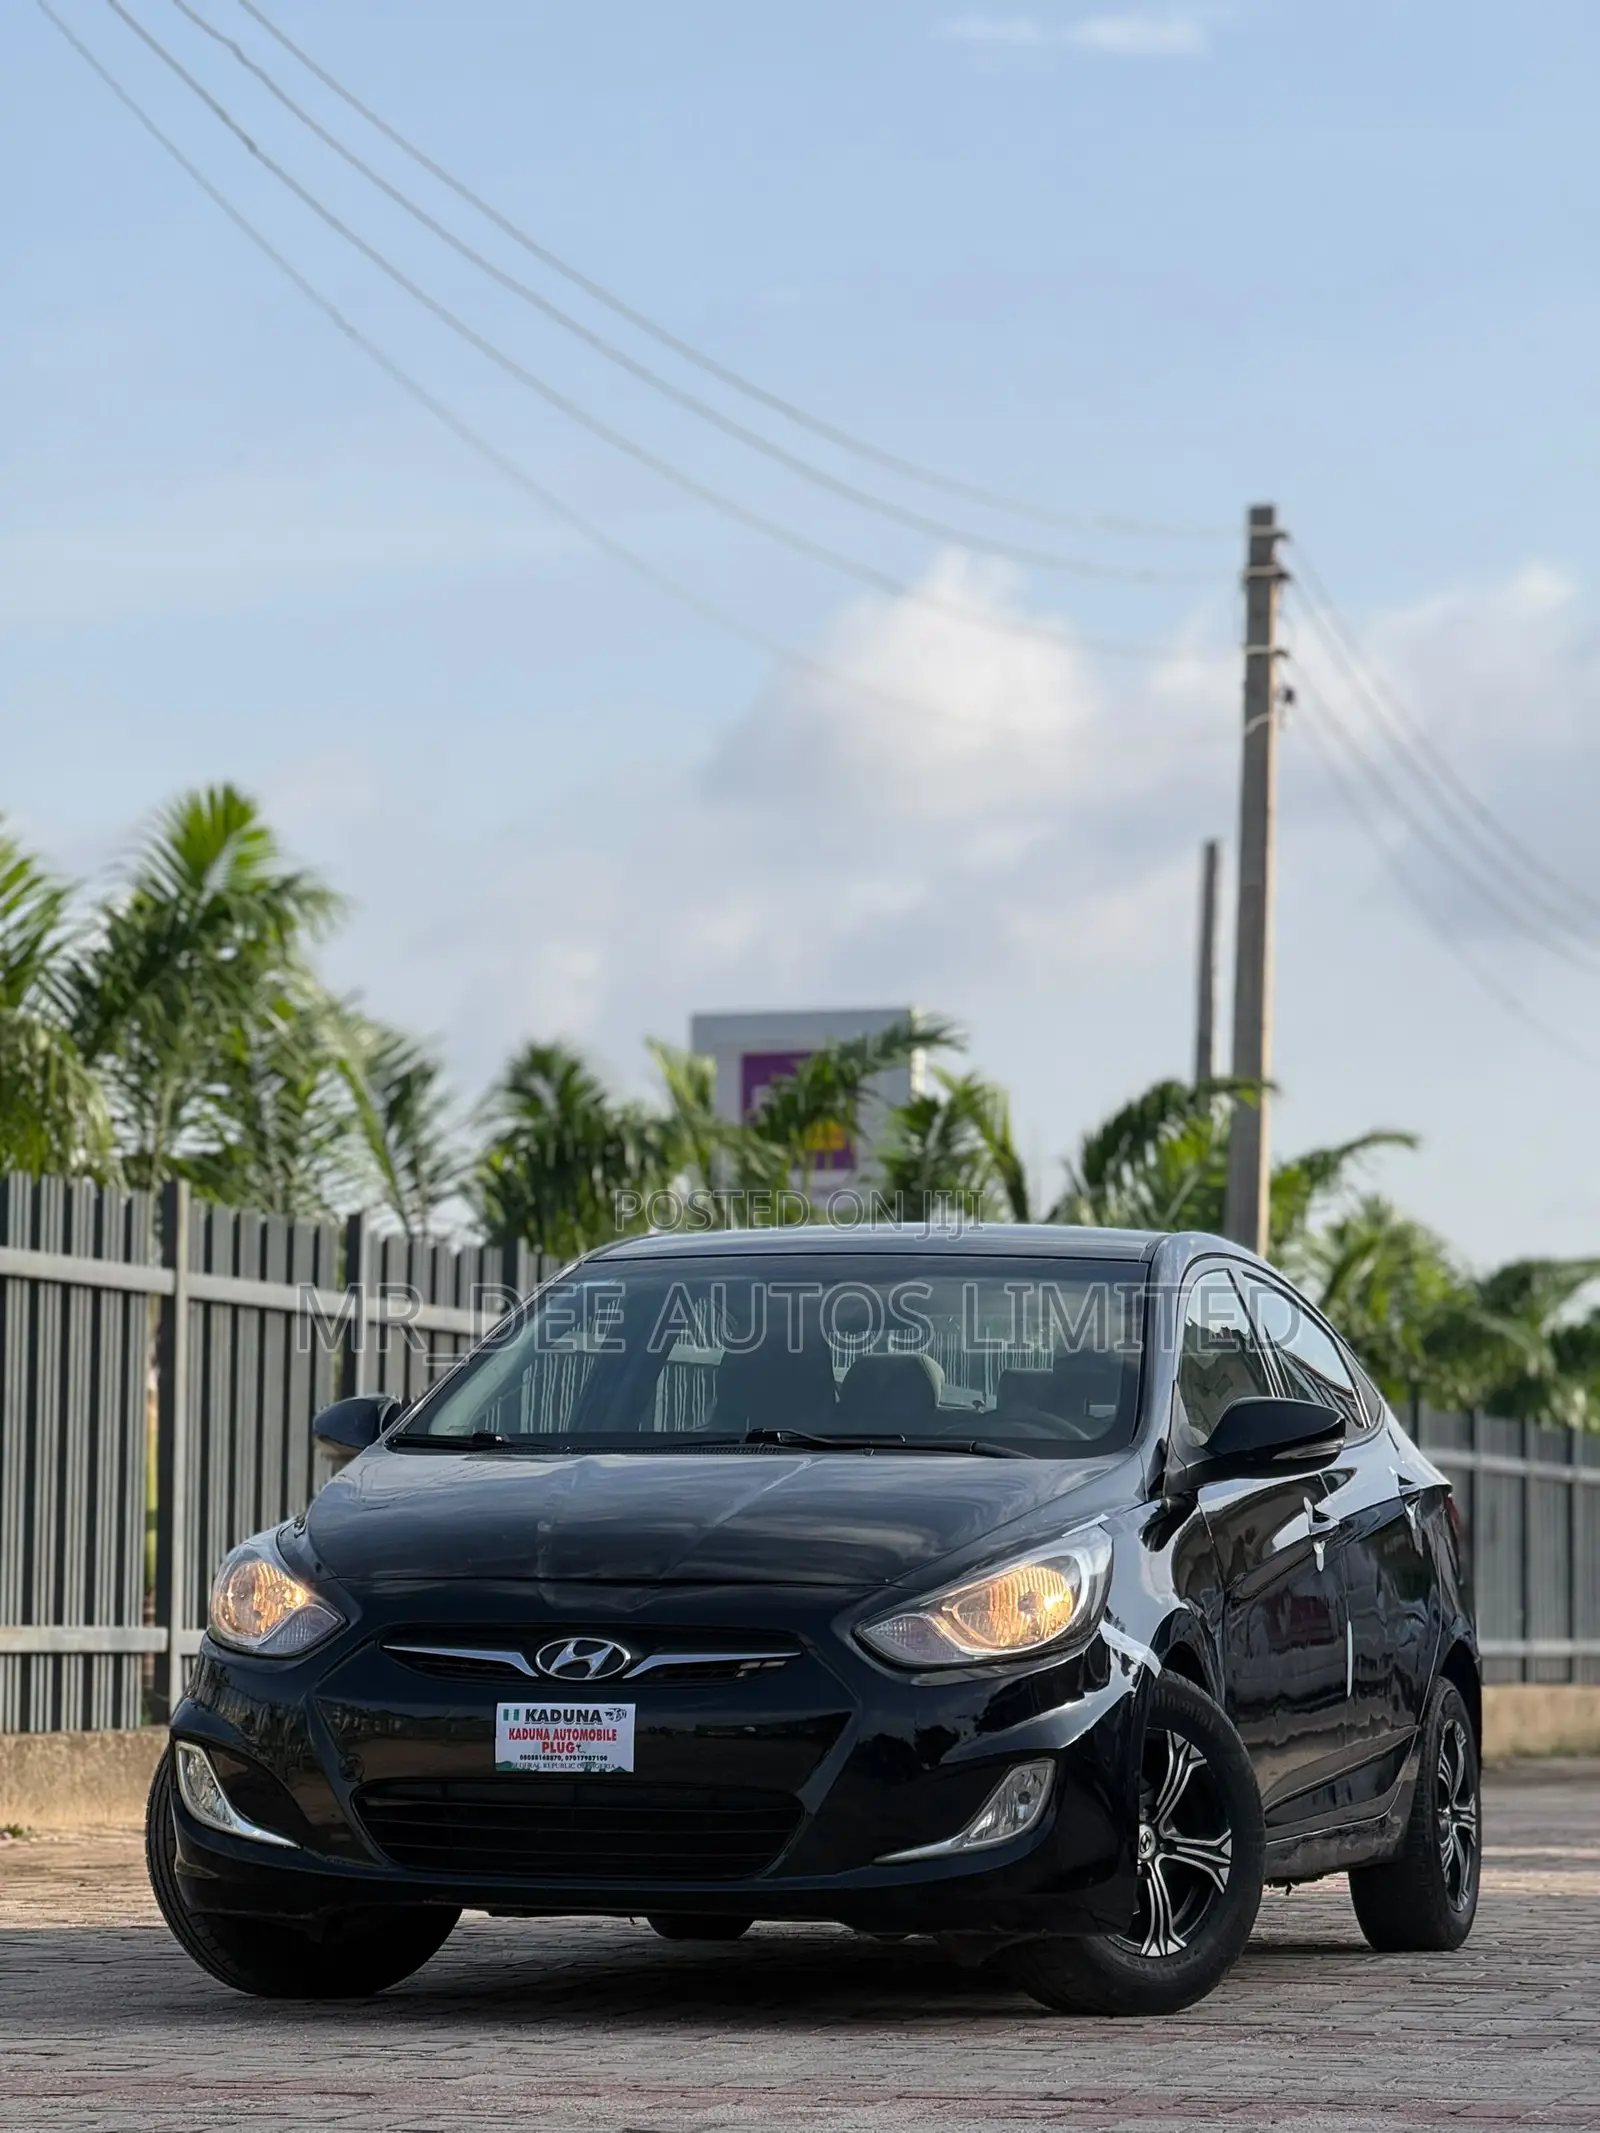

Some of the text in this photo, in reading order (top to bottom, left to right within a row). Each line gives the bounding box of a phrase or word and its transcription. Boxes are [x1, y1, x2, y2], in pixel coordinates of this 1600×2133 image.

[524, 1708, 604, 1725] KADUNA
[508, 1728, 618, 1742] KADUNA AUTOMOBILE
[541, 1741, 576, 1754] PLUG
